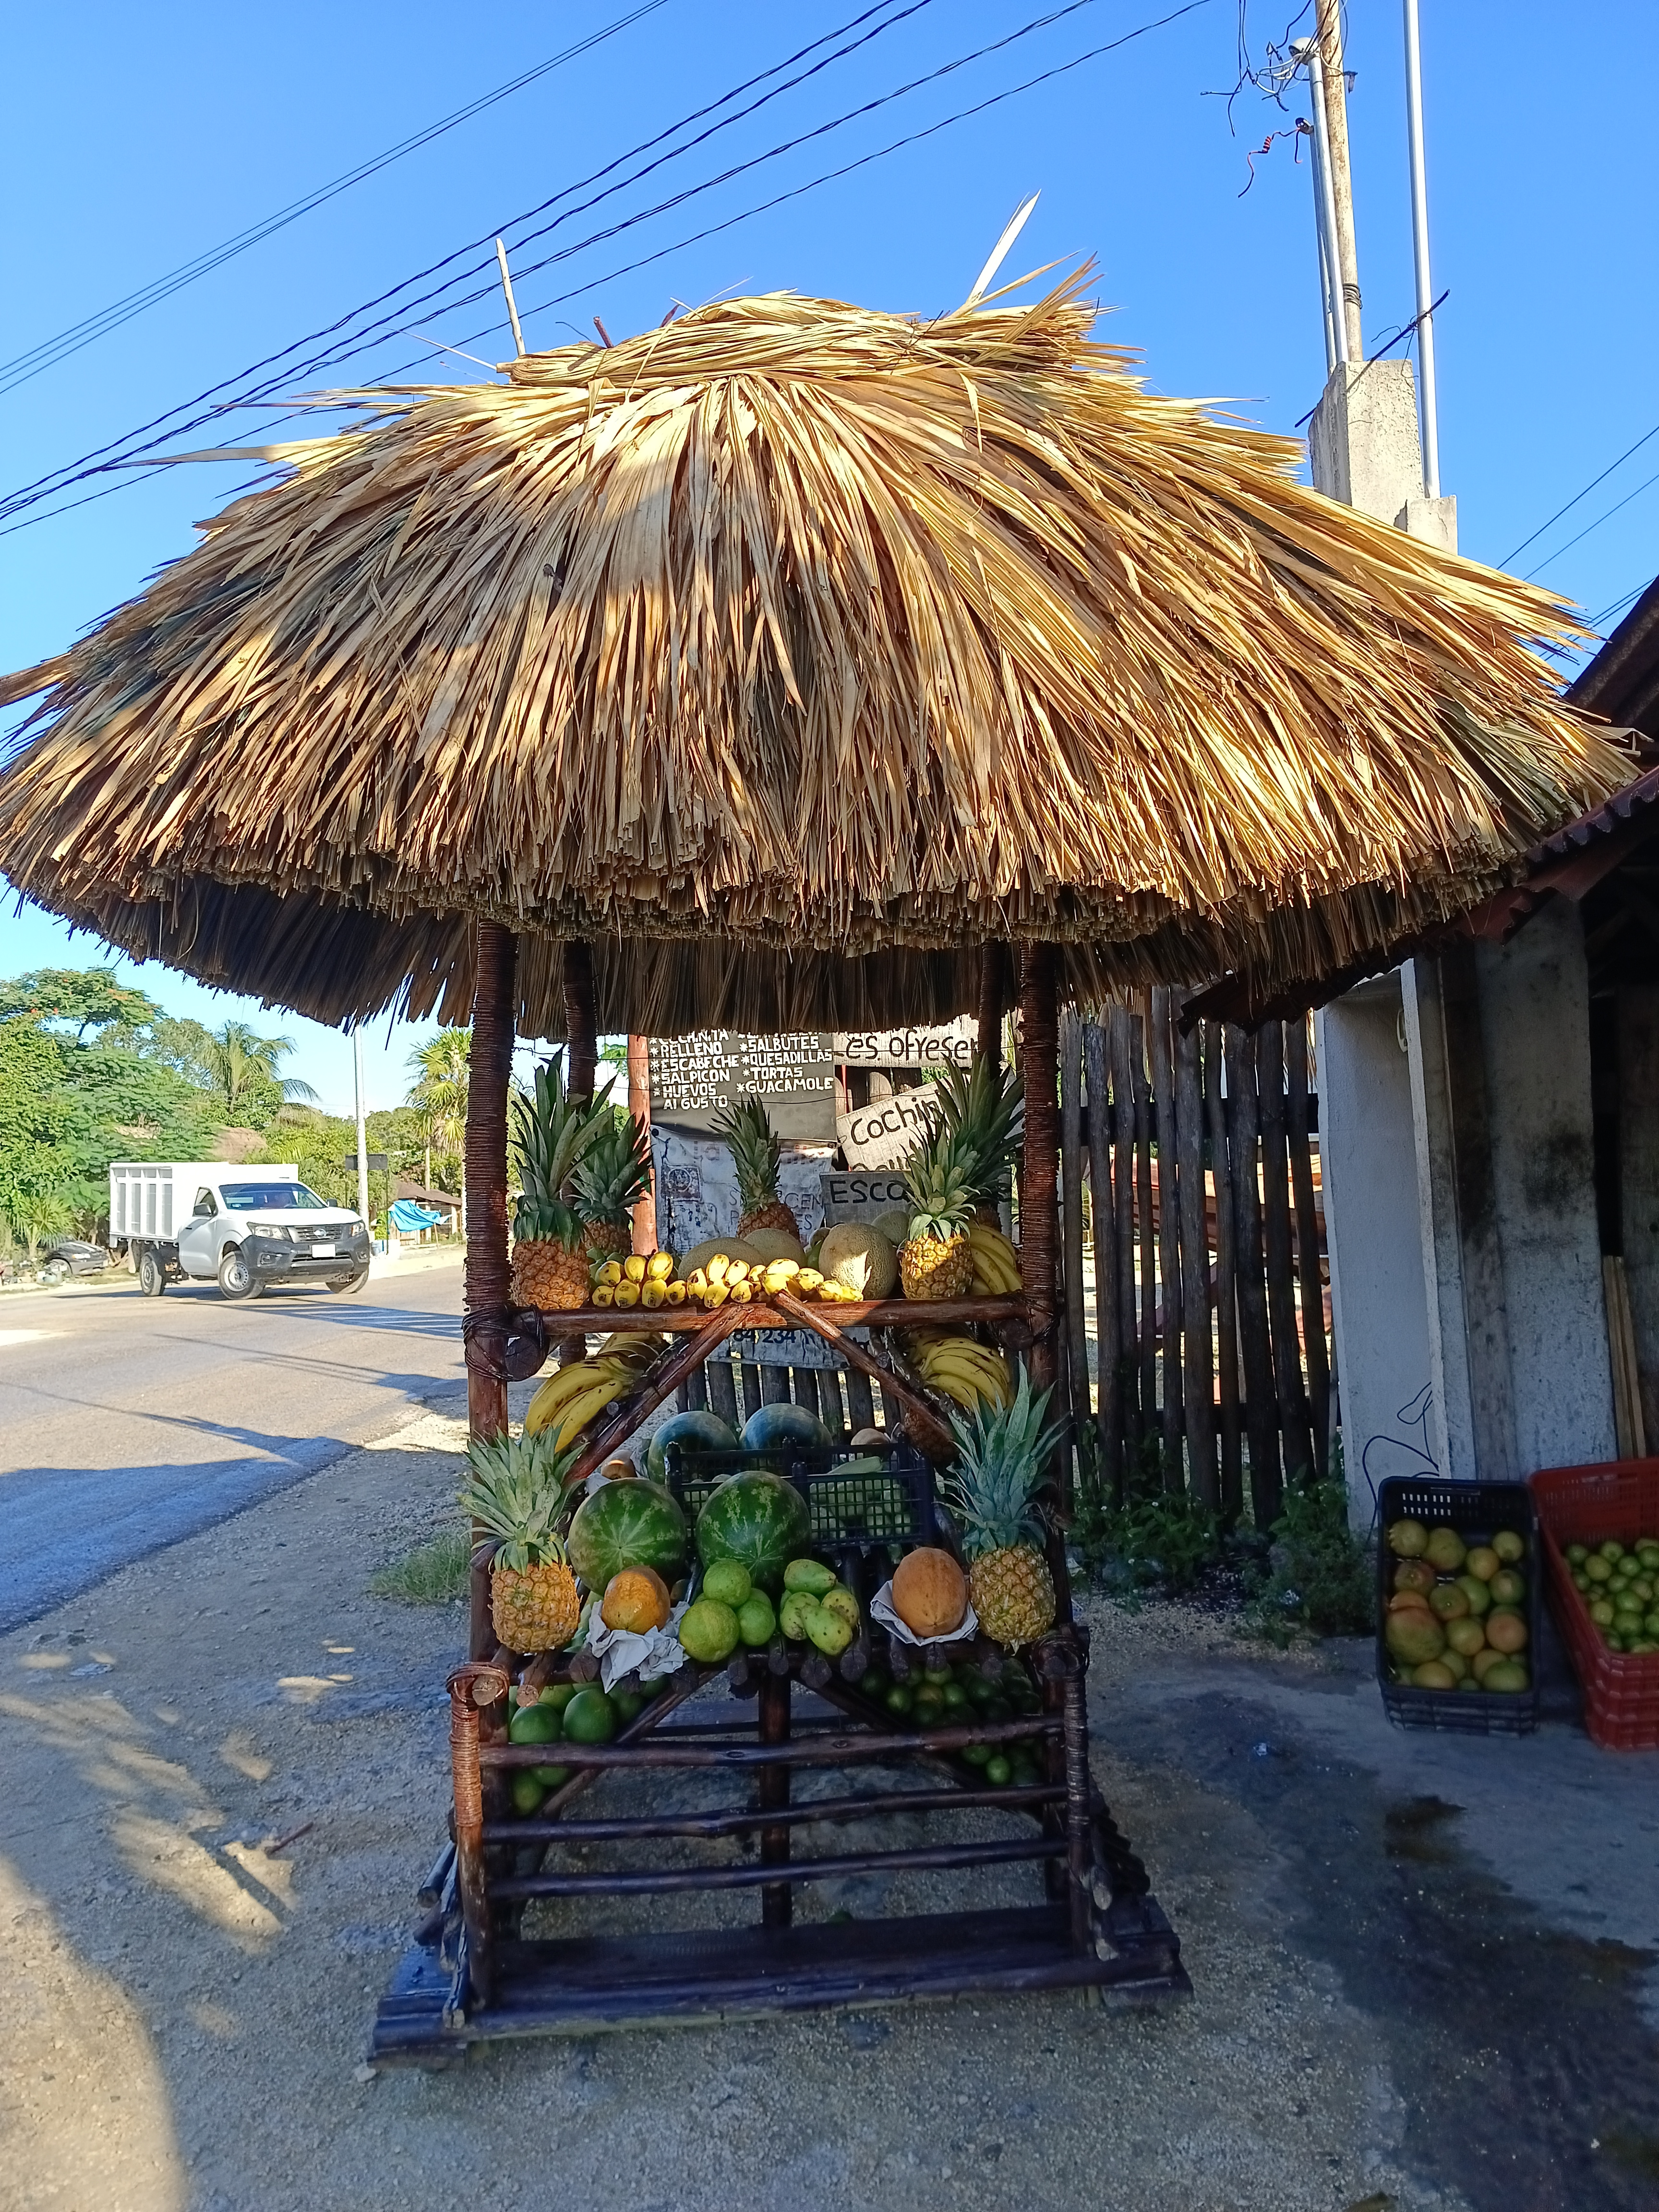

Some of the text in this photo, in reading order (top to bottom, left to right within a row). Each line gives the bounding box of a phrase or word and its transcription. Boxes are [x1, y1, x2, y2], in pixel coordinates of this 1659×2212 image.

[661, 1041, 723, 1058] RELLENO
[748, 1036, 819, 1053] SALBUTES
[661, 1055, 739, 1072] ESCABECHE
[750, 1048, 832, 1067] QUESADILLAS
[661, 1069, 731, 1084] SALPICON
[750, 1067, 803, 1081] TORTAS
[663, 1082, 717, 1098] HUEVOS
[745, 1077, 834, 1094] GUACAMOLE
[681, 1094, 728, 1110] GUSTO
[851, 1097, 940, 1145] Cochin
[784, 1192, 823, 1210] CEN
[761, 1329, 796, 1344] 234
